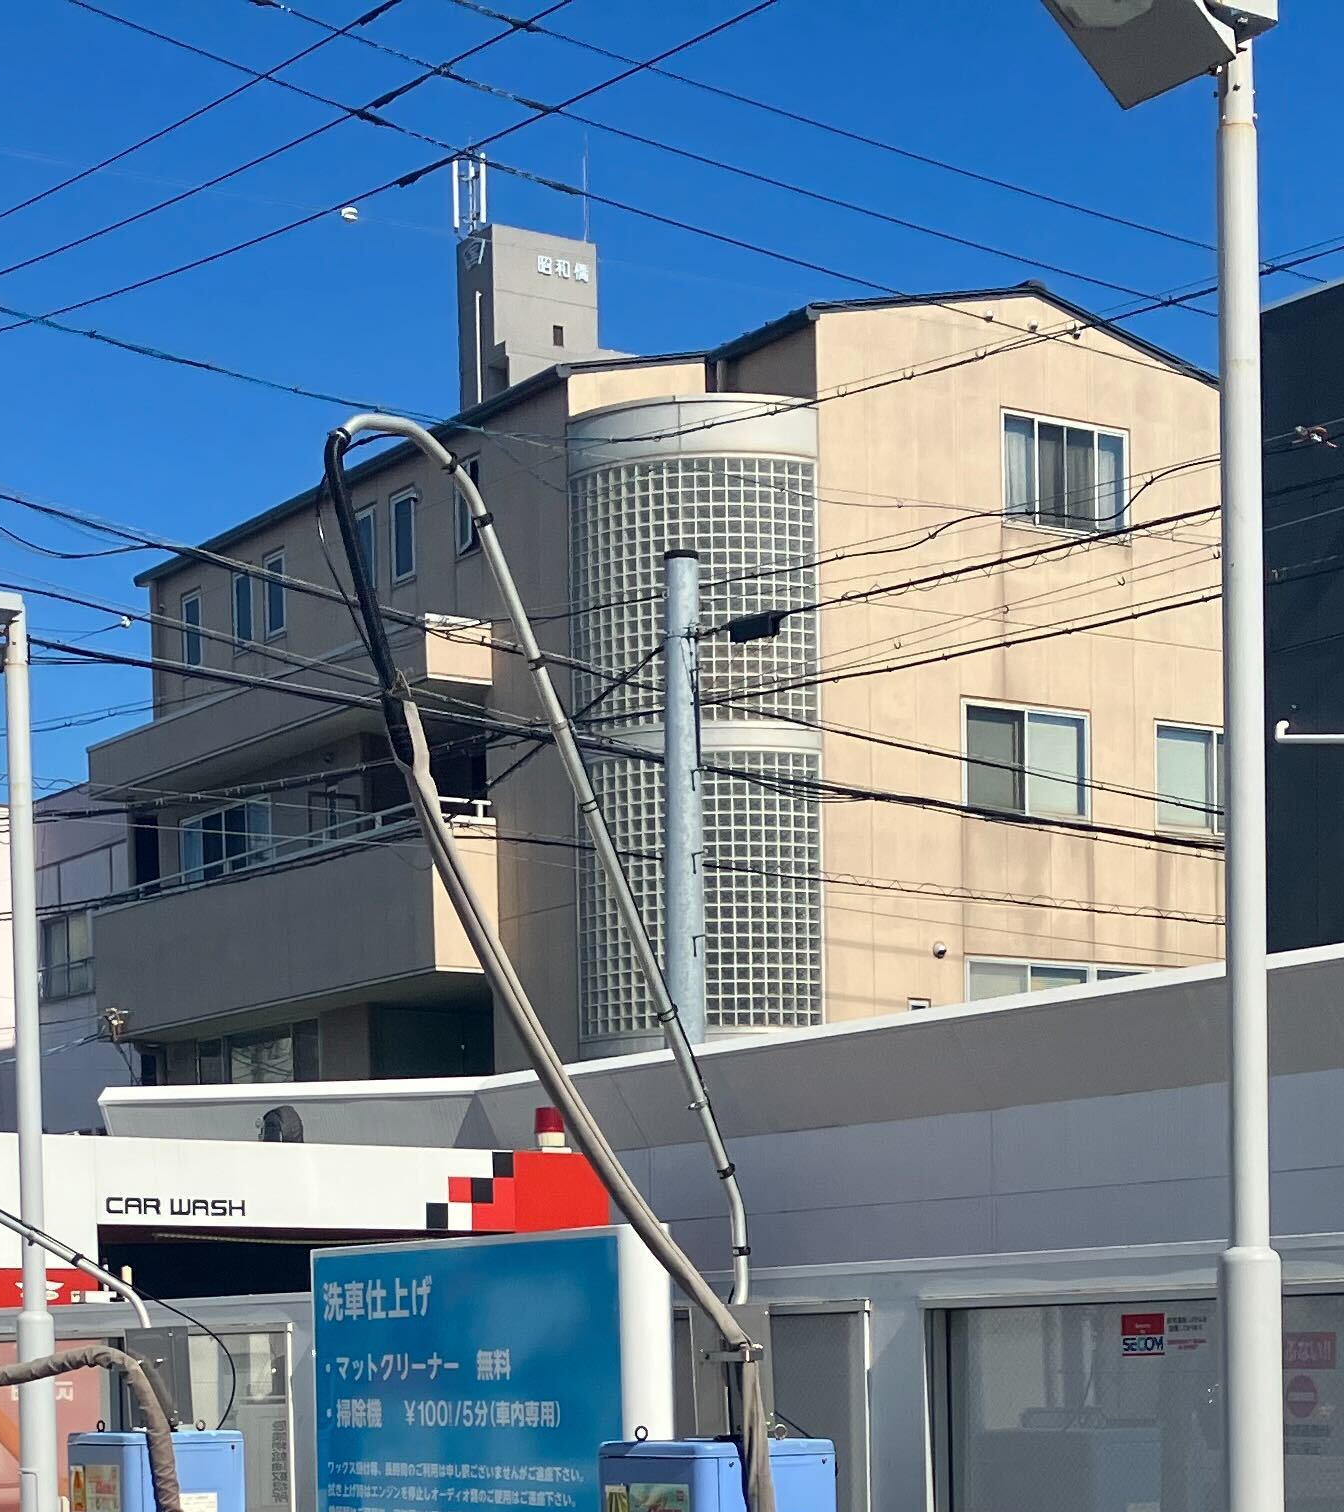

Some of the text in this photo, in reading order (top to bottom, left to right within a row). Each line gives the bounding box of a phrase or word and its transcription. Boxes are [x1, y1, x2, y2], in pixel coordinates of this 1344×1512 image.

[106, 1197, 246, 1217] CAR WASH
[322, 1275, 432, 1322] 洗車仕上げ
[1122, 1335, 1164, 1352] SECOM
[476, 1348, 512, 1381] 無料
